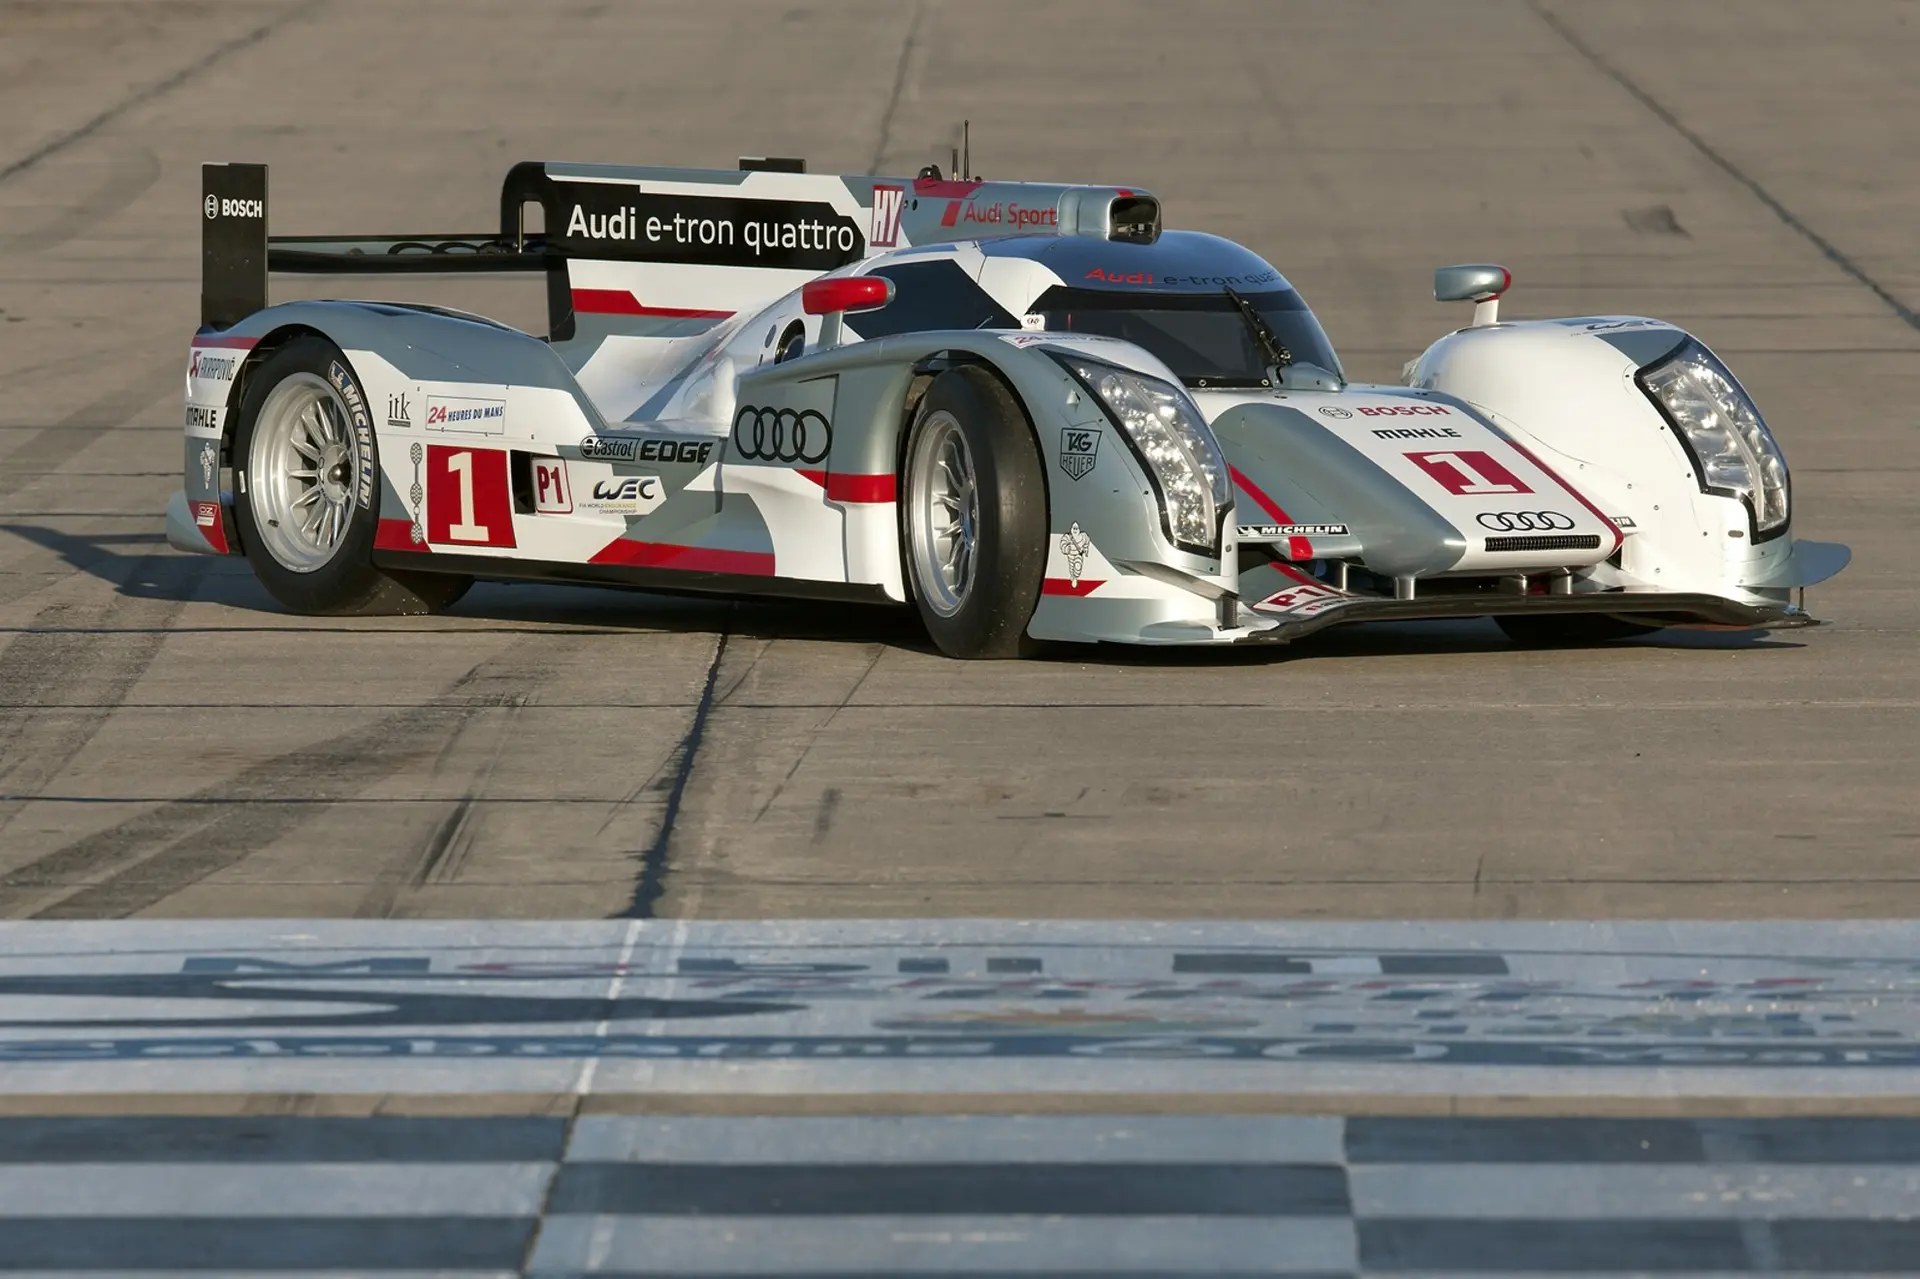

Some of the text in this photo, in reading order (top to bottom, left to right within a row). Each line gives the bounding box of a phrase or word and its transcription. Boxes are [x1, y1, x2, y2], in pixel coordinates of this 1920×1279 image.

[222, 198, 263, 218] BOSCH
[871, 190, 904, 244] HY
[963, 201, 1057, 229] Audi Sport
[566, 205, 854, 255] Audi e-tron quattro
[1084, 267, 1153, 285] Audi
[1163, 274, 1240, 286] e-tron
[388, 391, 411, 420] itk
[428, 406, 504, 424] 24 HEURES DU MANS
[1357, 405, 1451, 417] BOSCH
[186, 407, 217, 428] MAHLE
[343, 383, 372, 505] MICHELIN
[1067, 432, 1093, 452] TAG
[1371, 428, 1462, 440] MAHLE
[594, 438, 713, 464] Castrol EDGE
[1063, 456, 1093, 477] HEUER
[1423, 453, 1519, 494] 1
[537, 465, 564, 504] P1
[593, 478, 656, 500] WEC
[447, 451, 490, 542] 1
[1261, 525, 1343, 534] MICHELIN
[1267, 588, 1325, 607] P1
